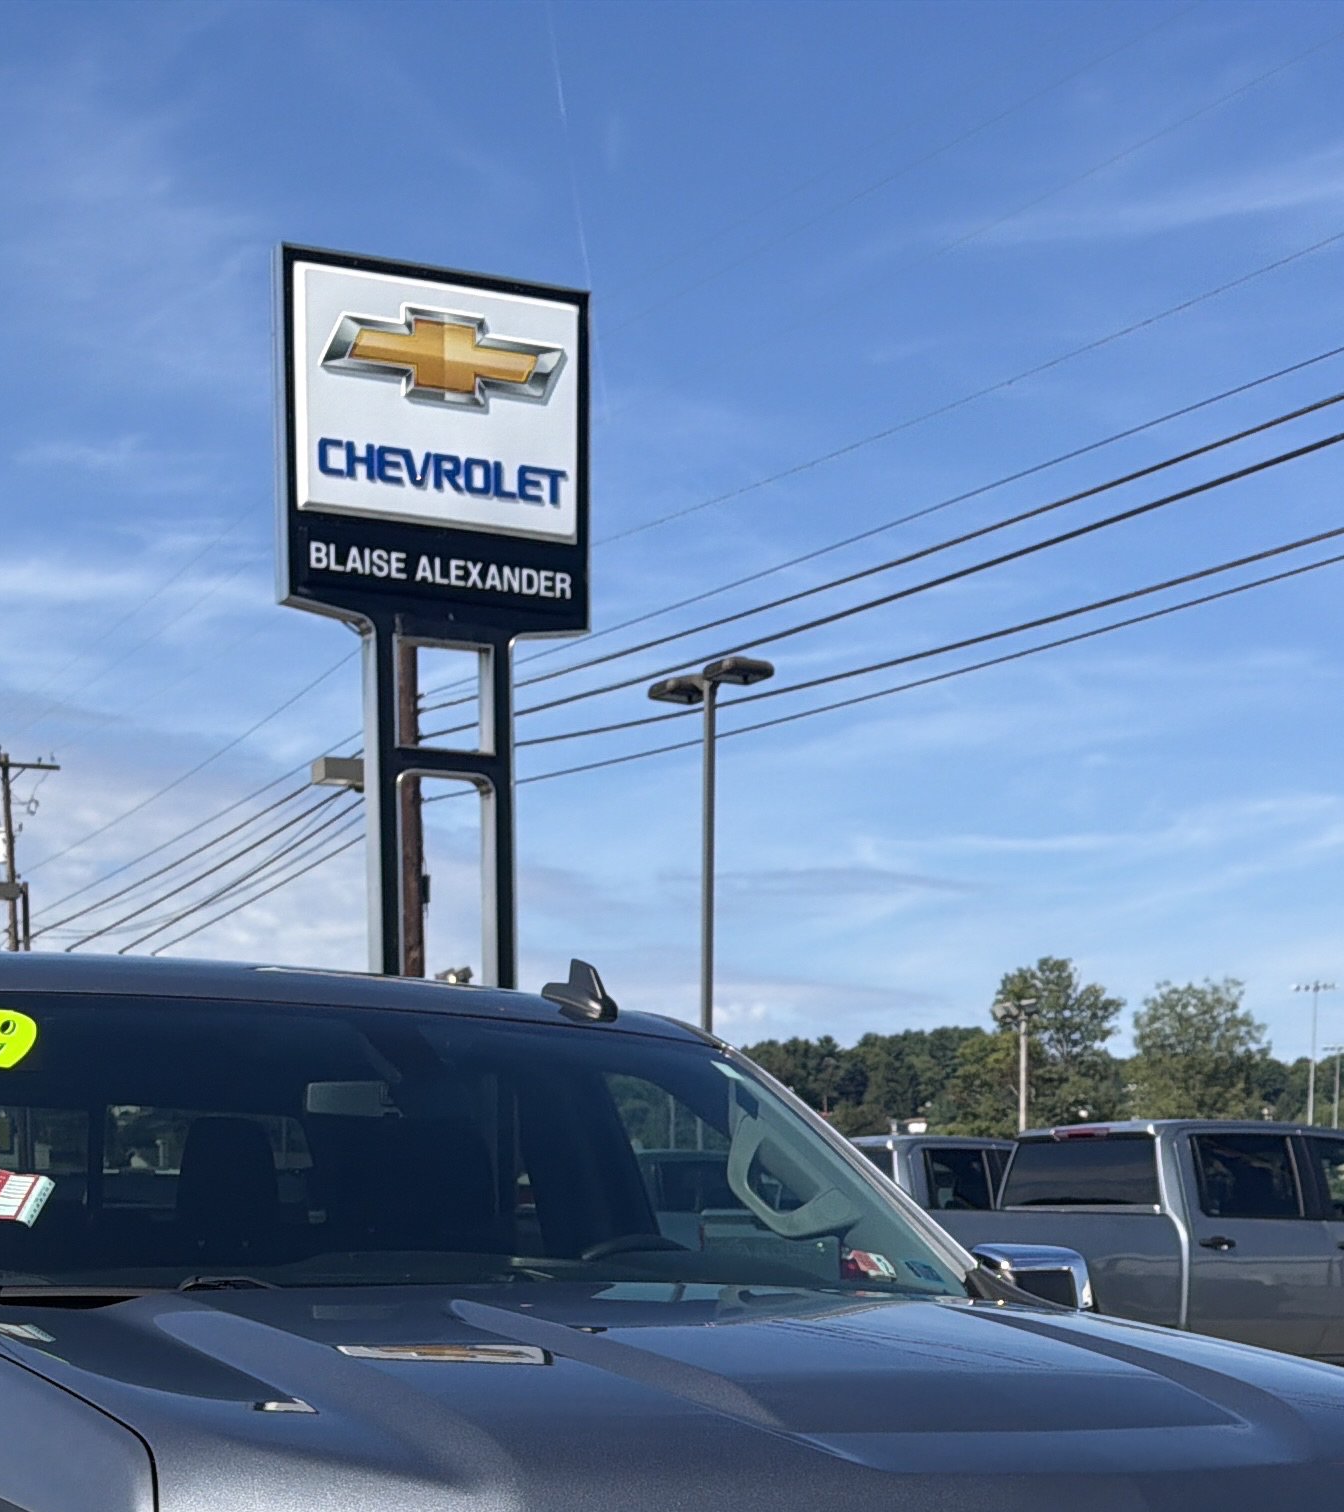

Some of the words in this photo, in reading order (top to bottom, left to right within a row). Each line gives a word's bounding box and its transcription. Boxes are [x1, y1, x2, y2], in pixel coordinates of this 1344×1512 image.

[317, 436, 567, 506] CHEVROLET
[309, 540, 407, 580] BLAISE
[415, 555, 572, 600] ALEXANDER
